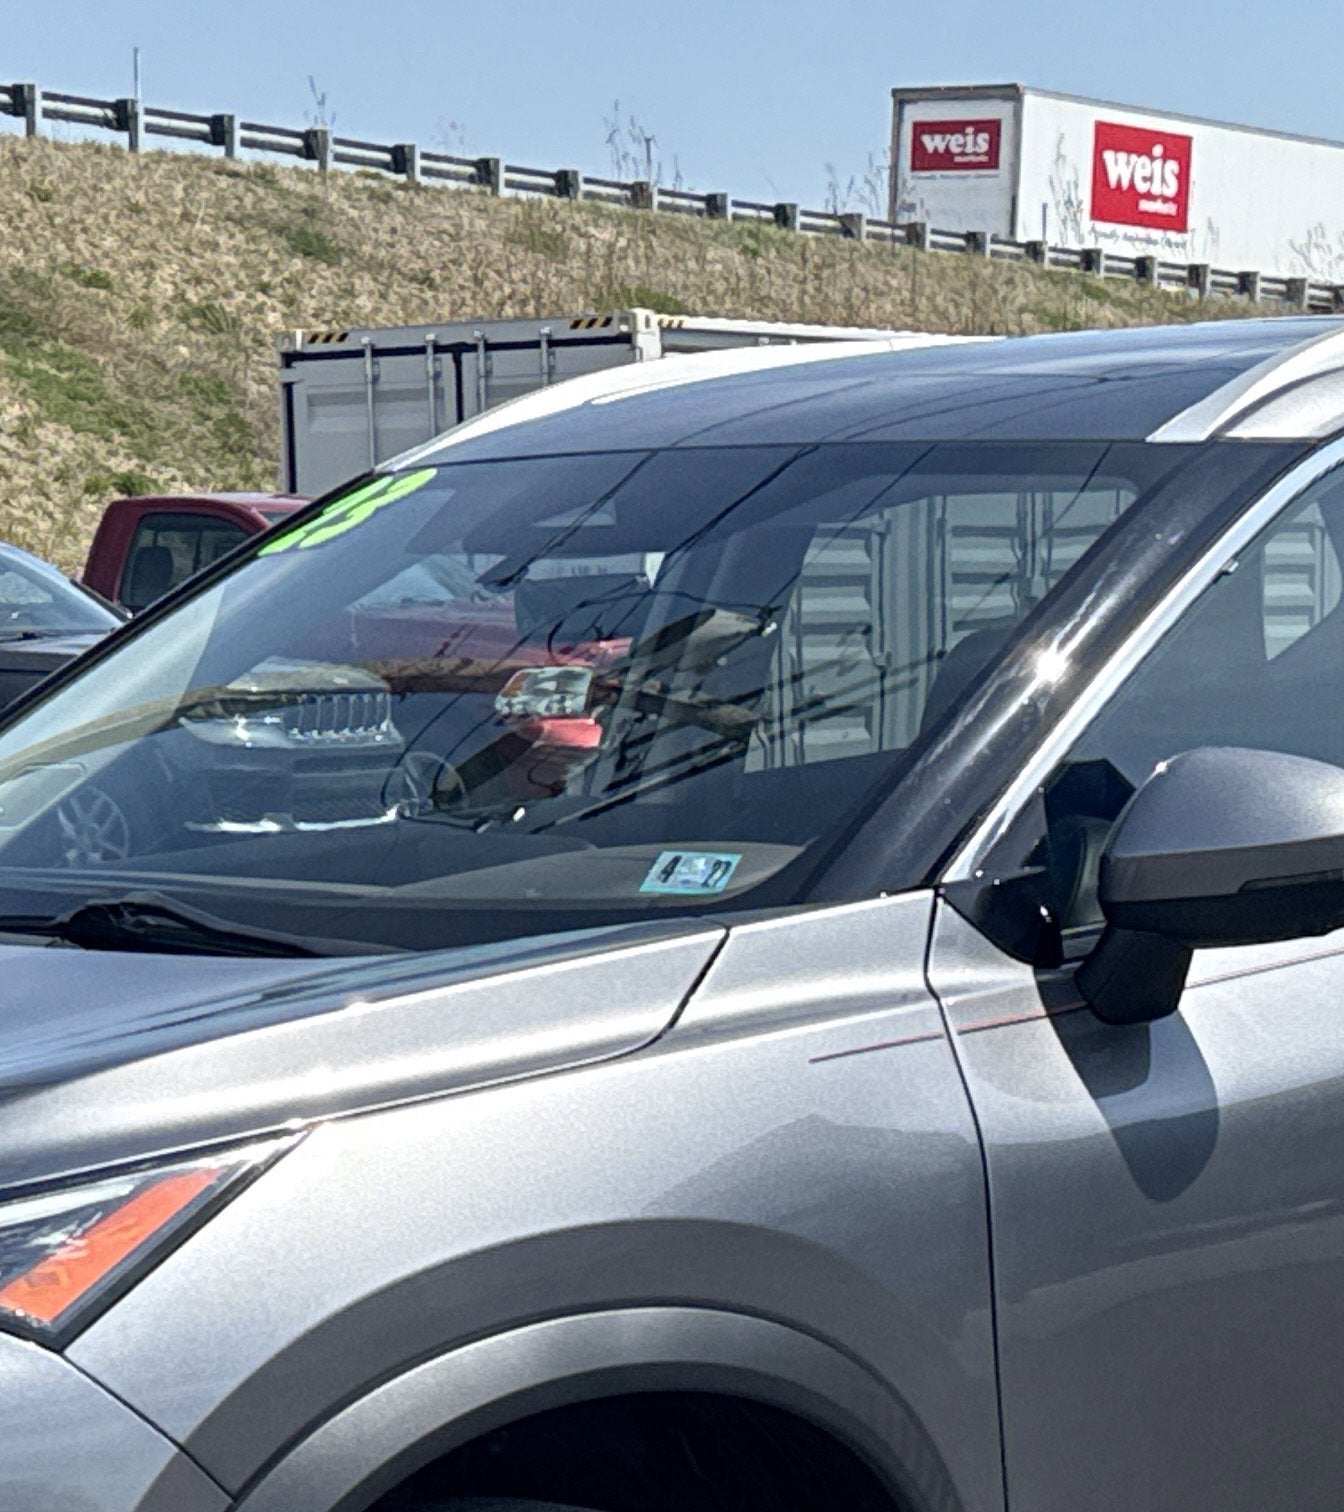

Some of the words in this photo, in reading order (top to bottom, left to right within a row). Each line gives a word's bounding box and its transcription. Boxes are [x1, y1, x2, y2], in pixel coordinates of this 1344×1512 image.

[920, 126, 990, 153] weis
[1102, 143, 1180, 198] weis
[660, 855, 682, 883] 4
